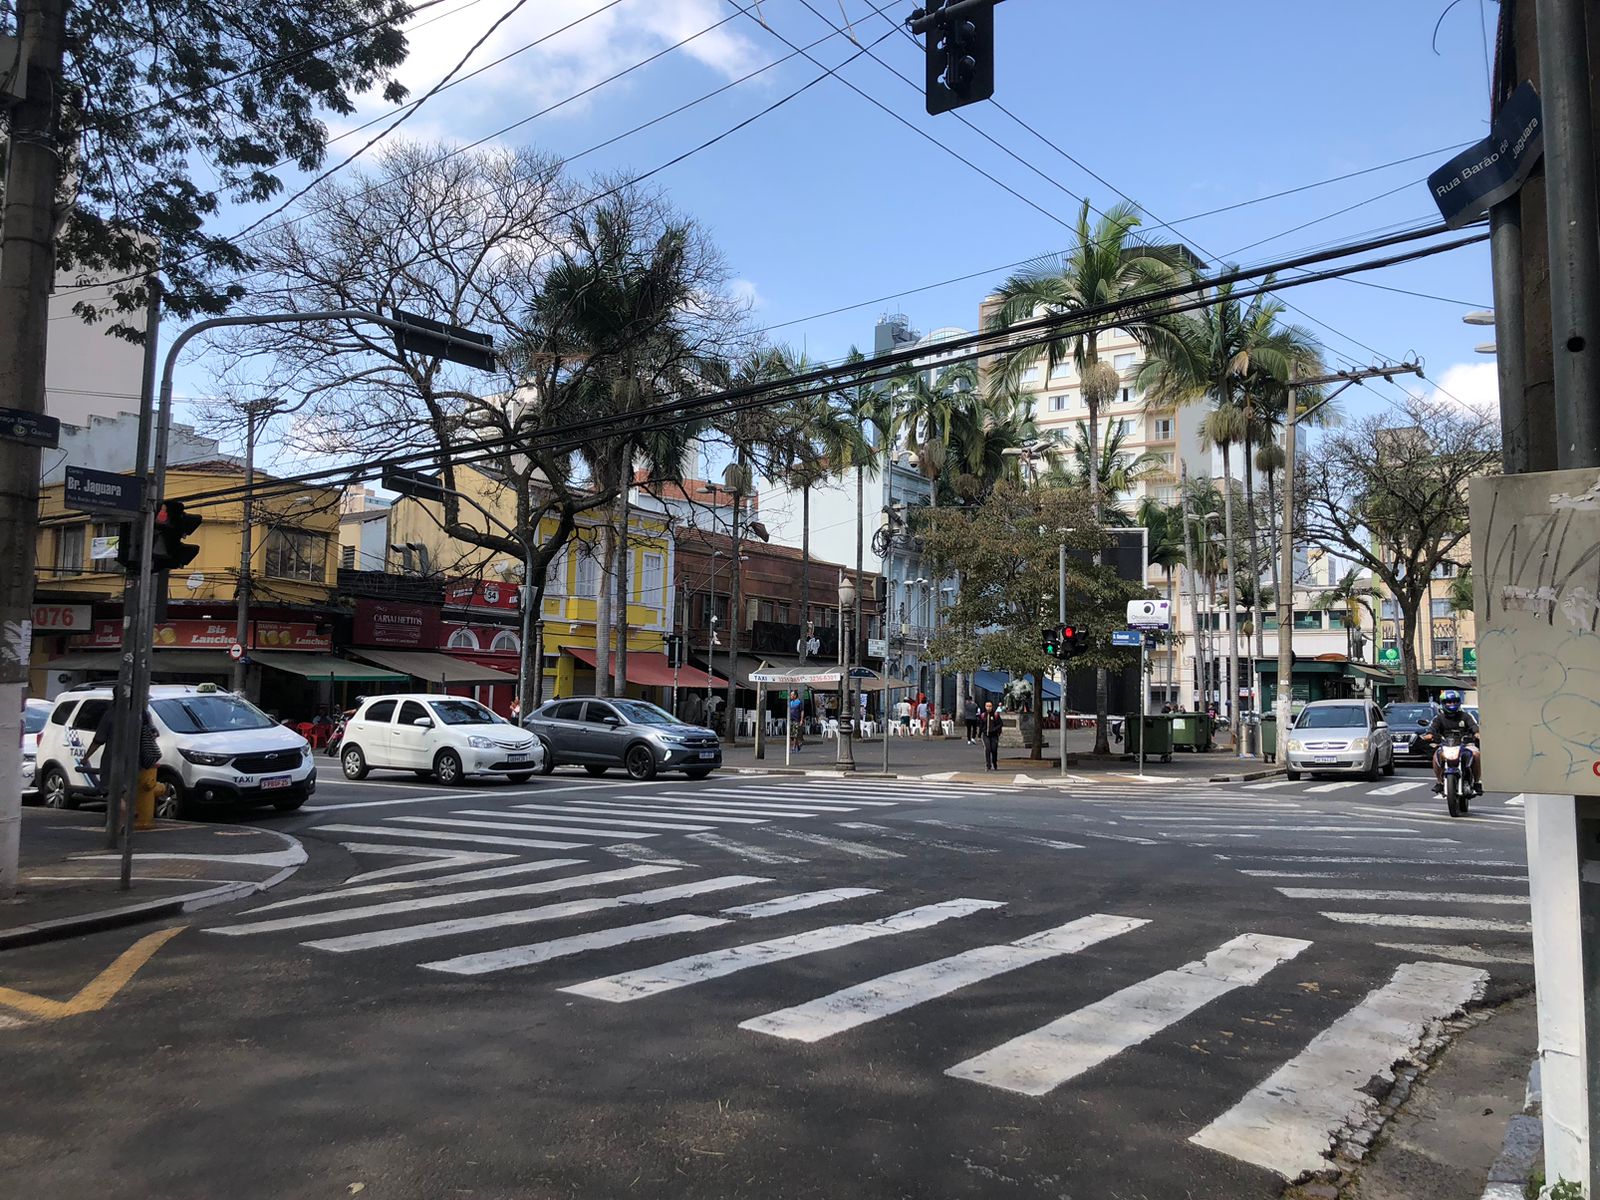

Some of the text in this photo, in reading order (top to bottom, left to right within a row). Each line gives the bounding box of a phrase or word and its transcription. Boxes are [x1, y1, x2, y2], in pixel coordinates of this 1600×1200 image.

[1513, 117, 1538, 159] Jaguara
[1436, 176, 1461, 197] Rua
[1462, 151, 1500, 180] Barão
[67, 476, 122, 497] Br. Jaguara
[207, 625, 227, 635] Bis
[70, 747, 87, 757] TAXI
[232, 776, 254, 784] TAXI
